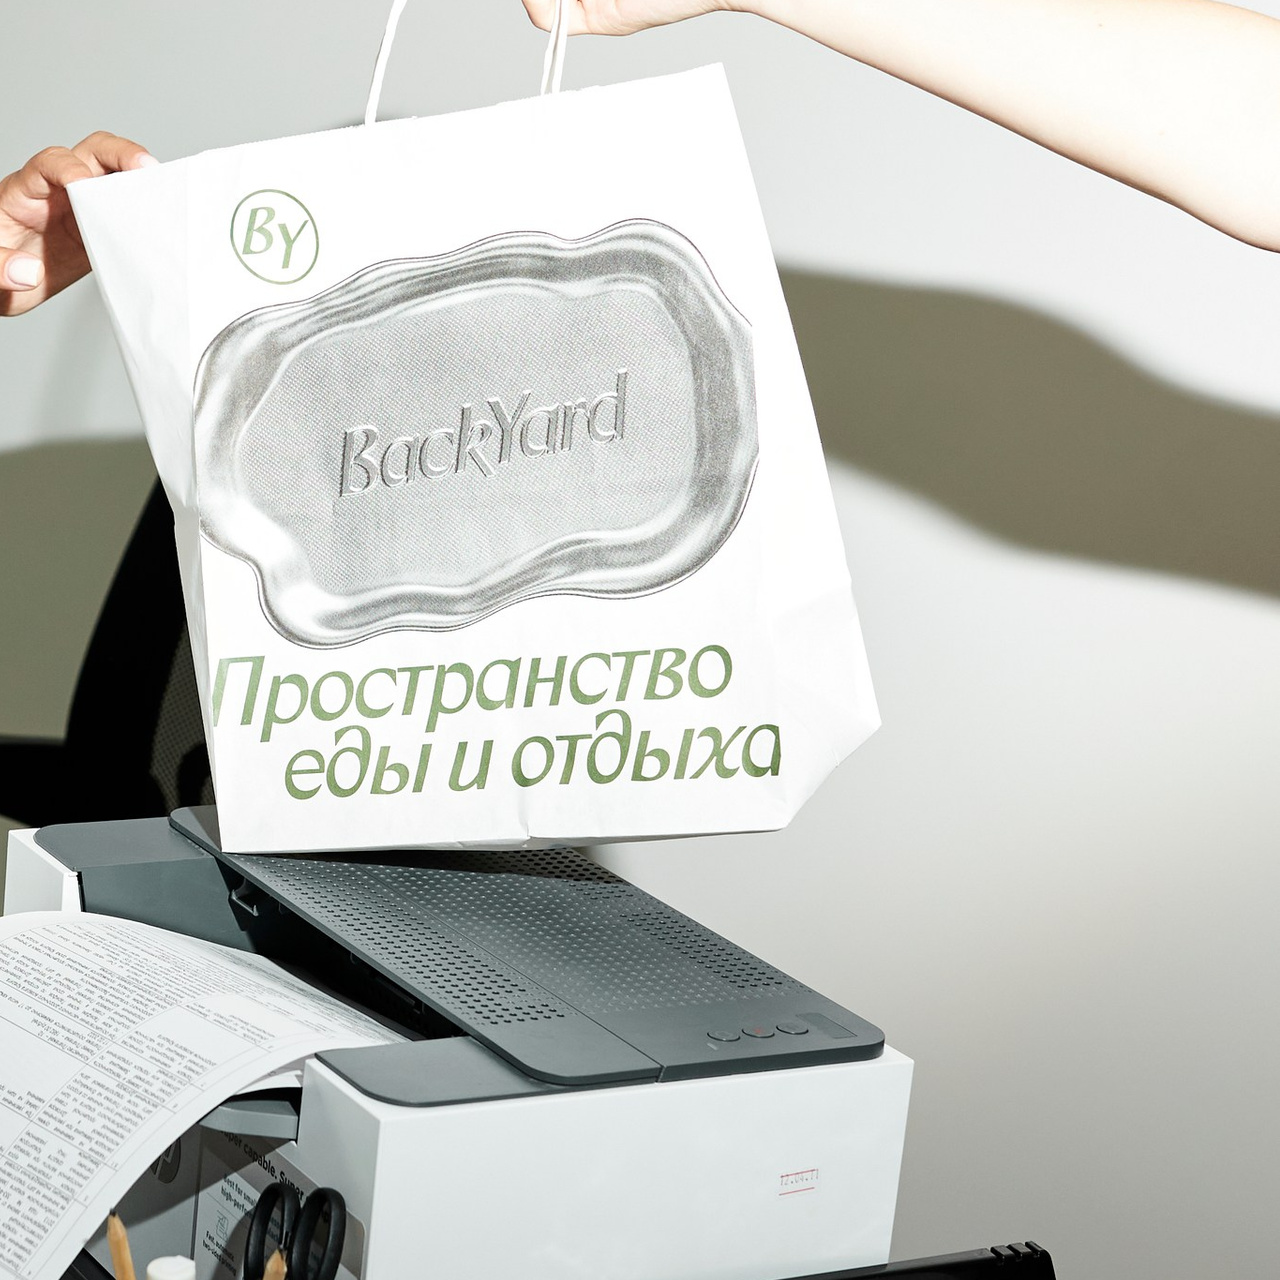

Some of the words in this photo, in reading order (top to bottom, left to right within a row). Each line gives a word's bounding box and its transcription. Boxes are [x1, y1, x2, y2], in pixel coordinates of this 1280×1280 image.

[241, 206, 309, 269] BY
[338, 366, 630, 500] BackYard
[212, 644, 733, 743] Пространство
[283, 725, 425, 802] еды
[448, 740, 490, 791] и
[512, 709, 781, 787] отдыха
[221, 1130, 242, 1147] uper
[243, 1143, 278, 1180] capable.
